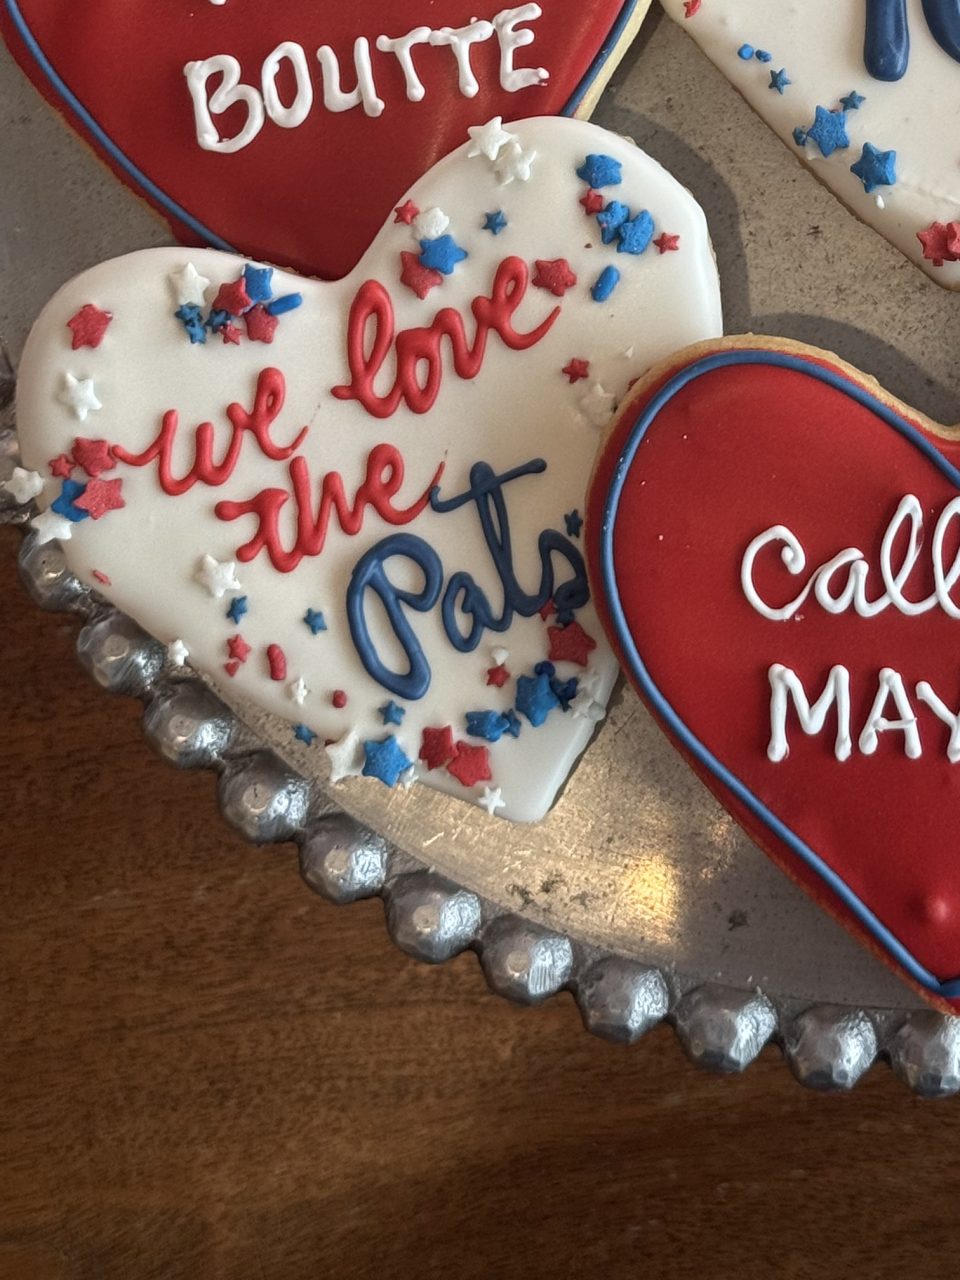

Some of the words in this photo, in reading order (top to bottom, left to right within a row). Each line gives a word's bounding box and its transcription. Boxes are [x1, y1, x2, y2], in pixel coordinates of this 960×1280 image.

[183, 2, 549, 153] BOUTTE
[111, 367, 308, 495] we
[331, 256, 561, 418] love
[214, 443, 445, 572] the
[346, 458, 590, 700] Pats
